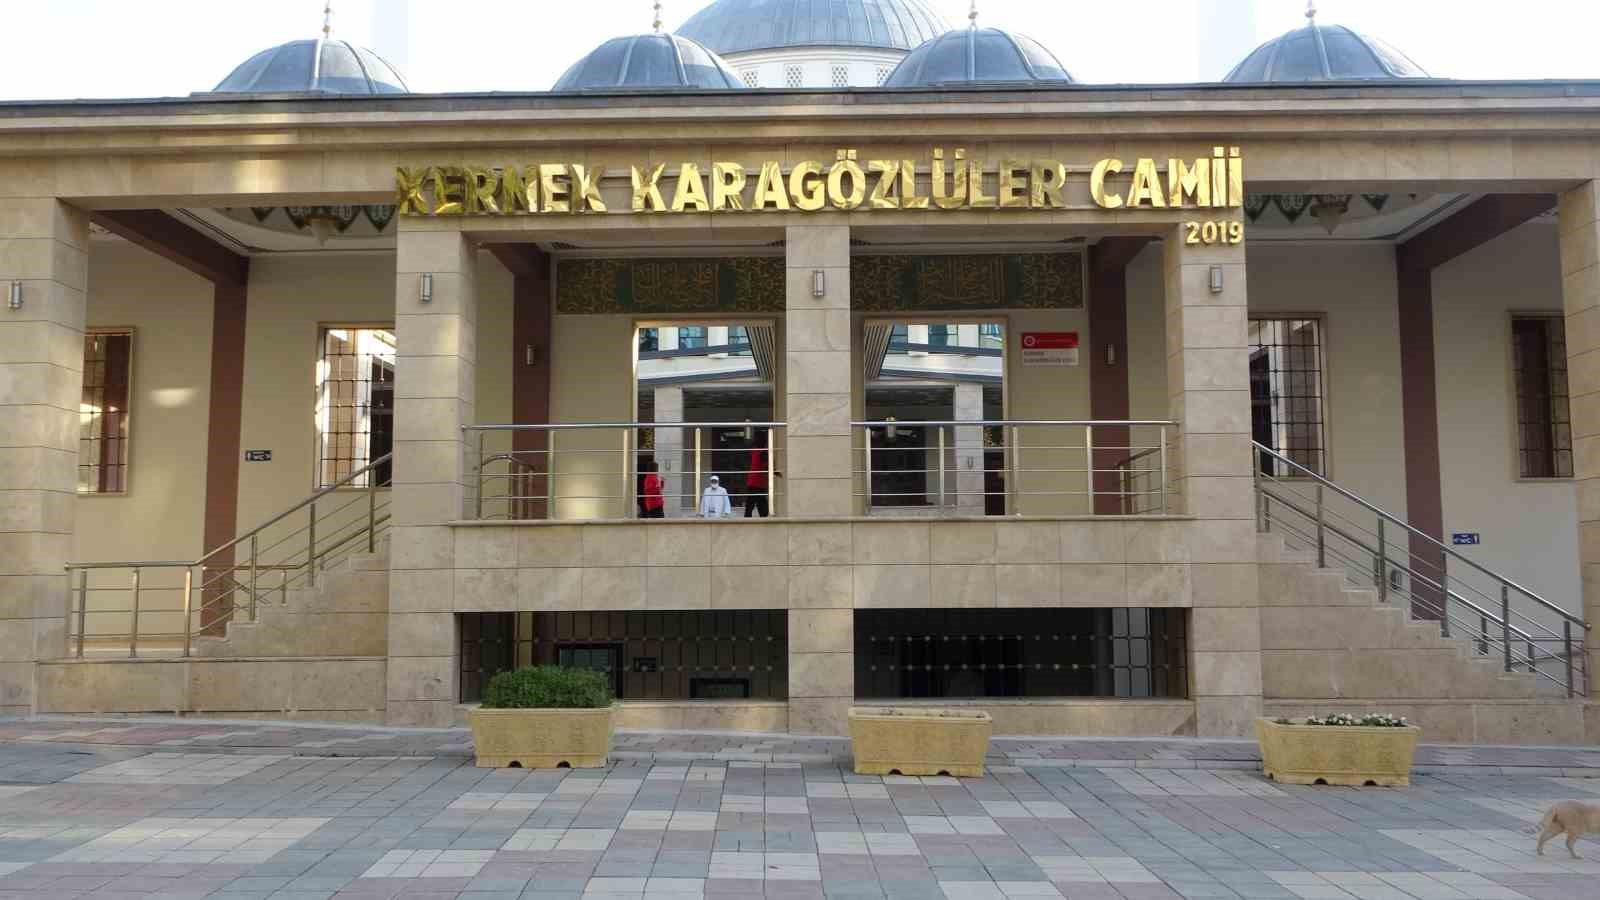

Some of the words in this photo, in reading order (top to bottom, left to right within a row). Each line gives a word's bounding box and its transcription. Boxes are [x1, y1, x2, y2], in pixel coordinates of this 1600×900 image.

[396, 164, 608, 216] KERMEK
[631, 148, 1066, 213] KARAGÖZLÜLER
[1090, 146, 1244, 210] CAMİİ
[1185, 221, 1244, 245] 2019
